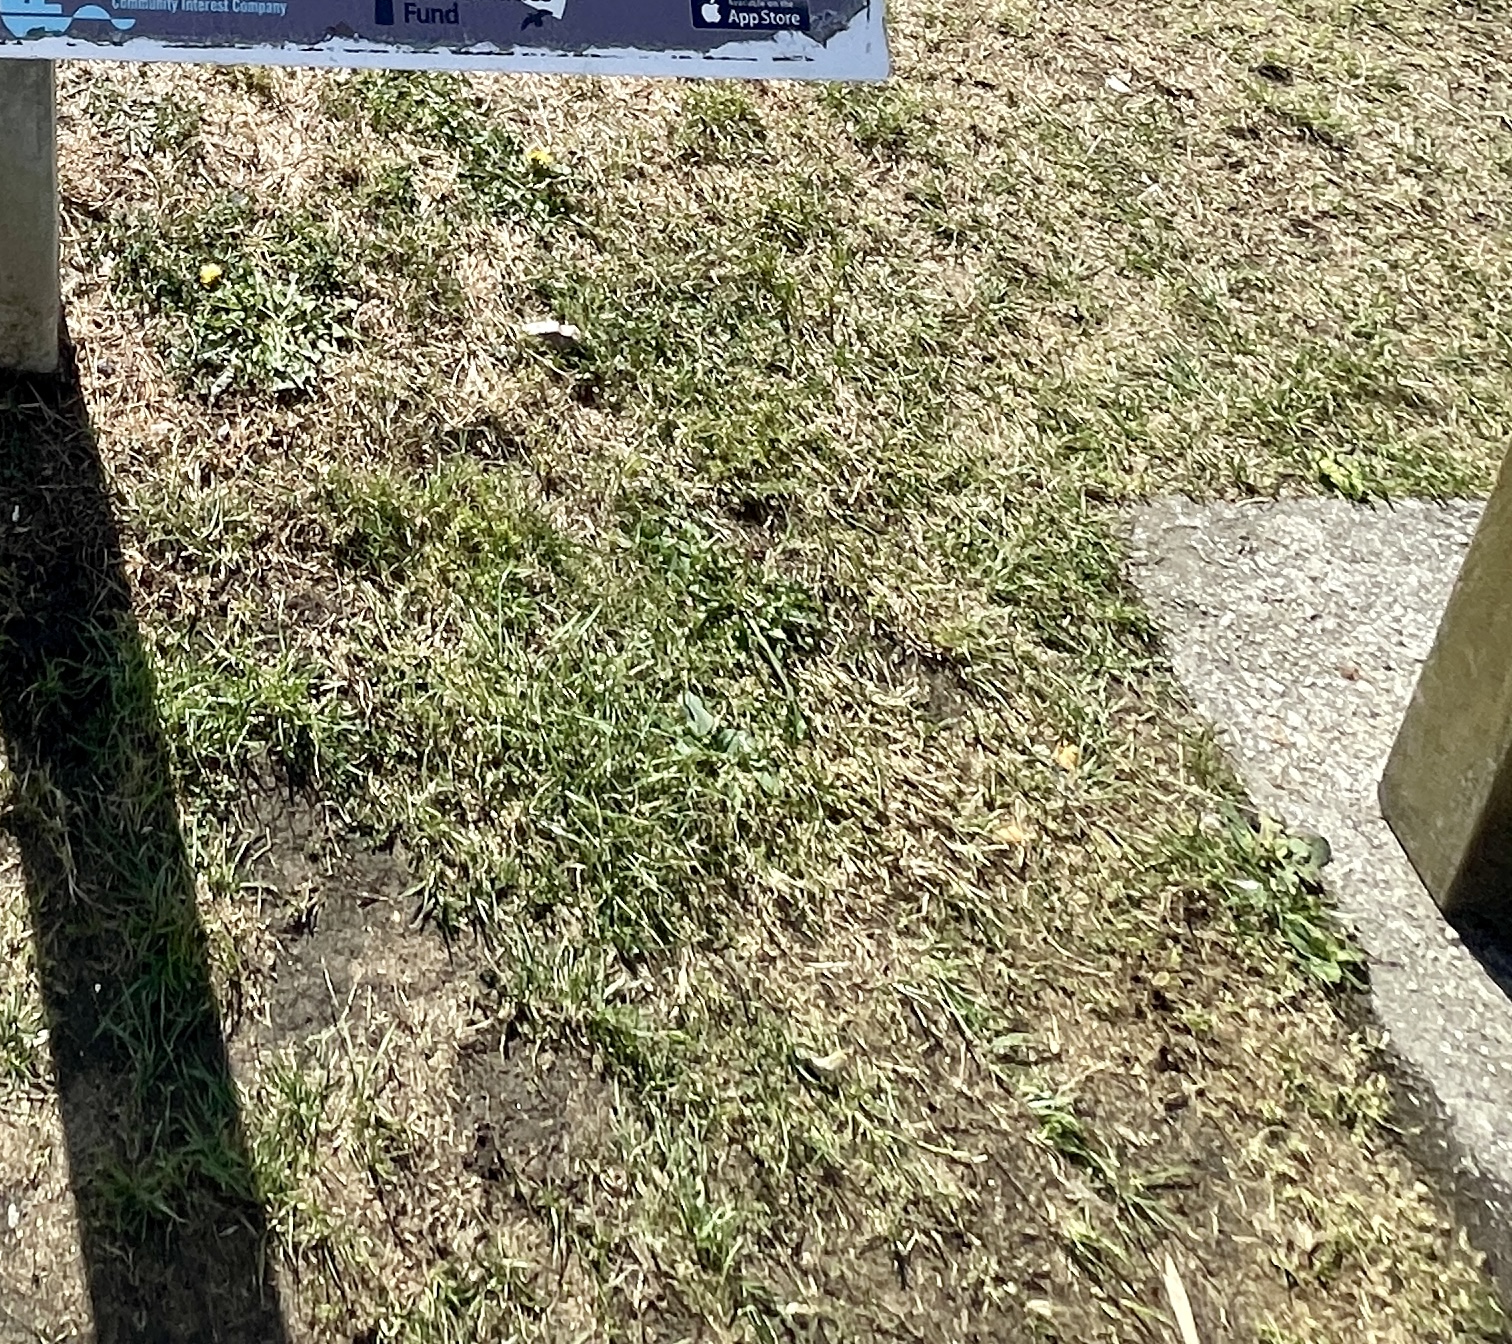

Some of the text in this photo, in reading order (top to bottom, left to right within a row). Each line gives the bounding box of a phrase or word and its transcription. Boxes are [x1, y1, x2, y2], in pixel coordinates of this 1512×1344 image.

[403, 2, 460, 25] Fund
[728, 8, 801, 28] App Store
